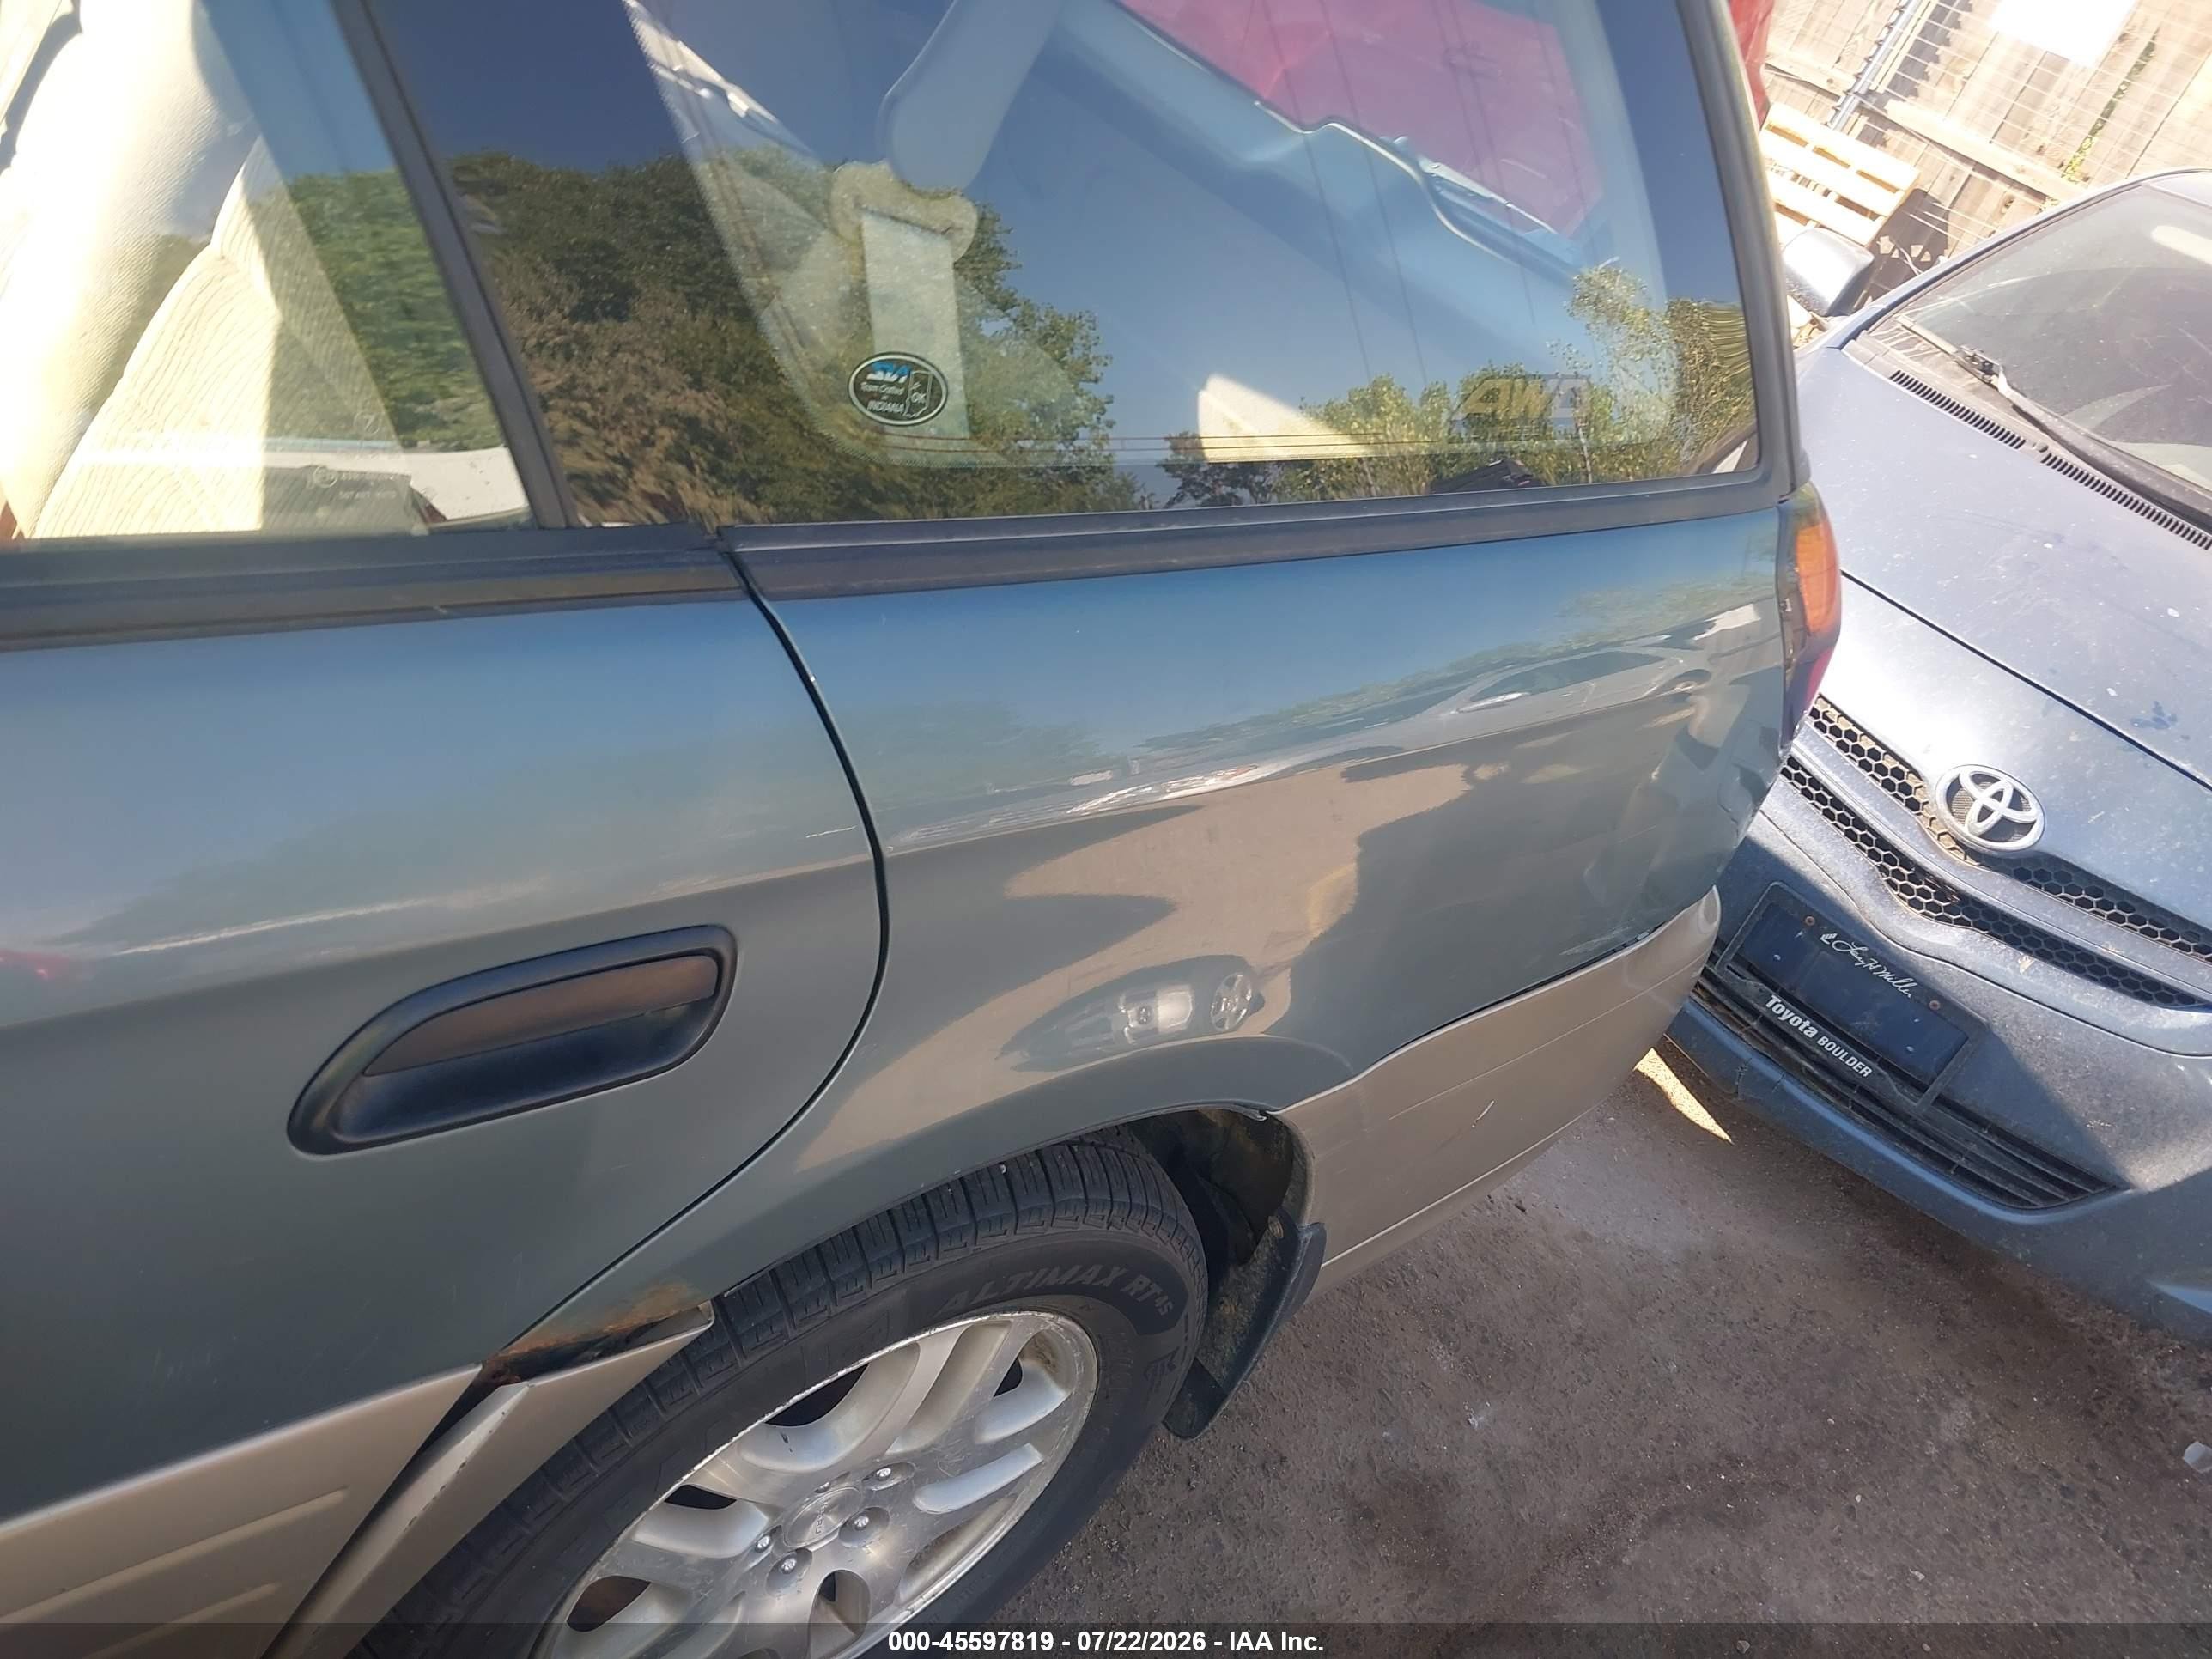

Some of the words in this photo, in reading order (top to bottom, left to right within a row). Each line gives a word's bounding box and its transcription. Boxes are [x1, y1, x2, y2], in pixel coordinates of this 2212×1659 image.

[1451, 376, 1590, 420] AWD
[1873, 966, 1917, 998] Miller
[1765, 995, 1818, 1038] Toyota
[1817, 1036, 1872, 1078] BOULDER
[933, 1264, 1128, 1319] ALTIMAX
